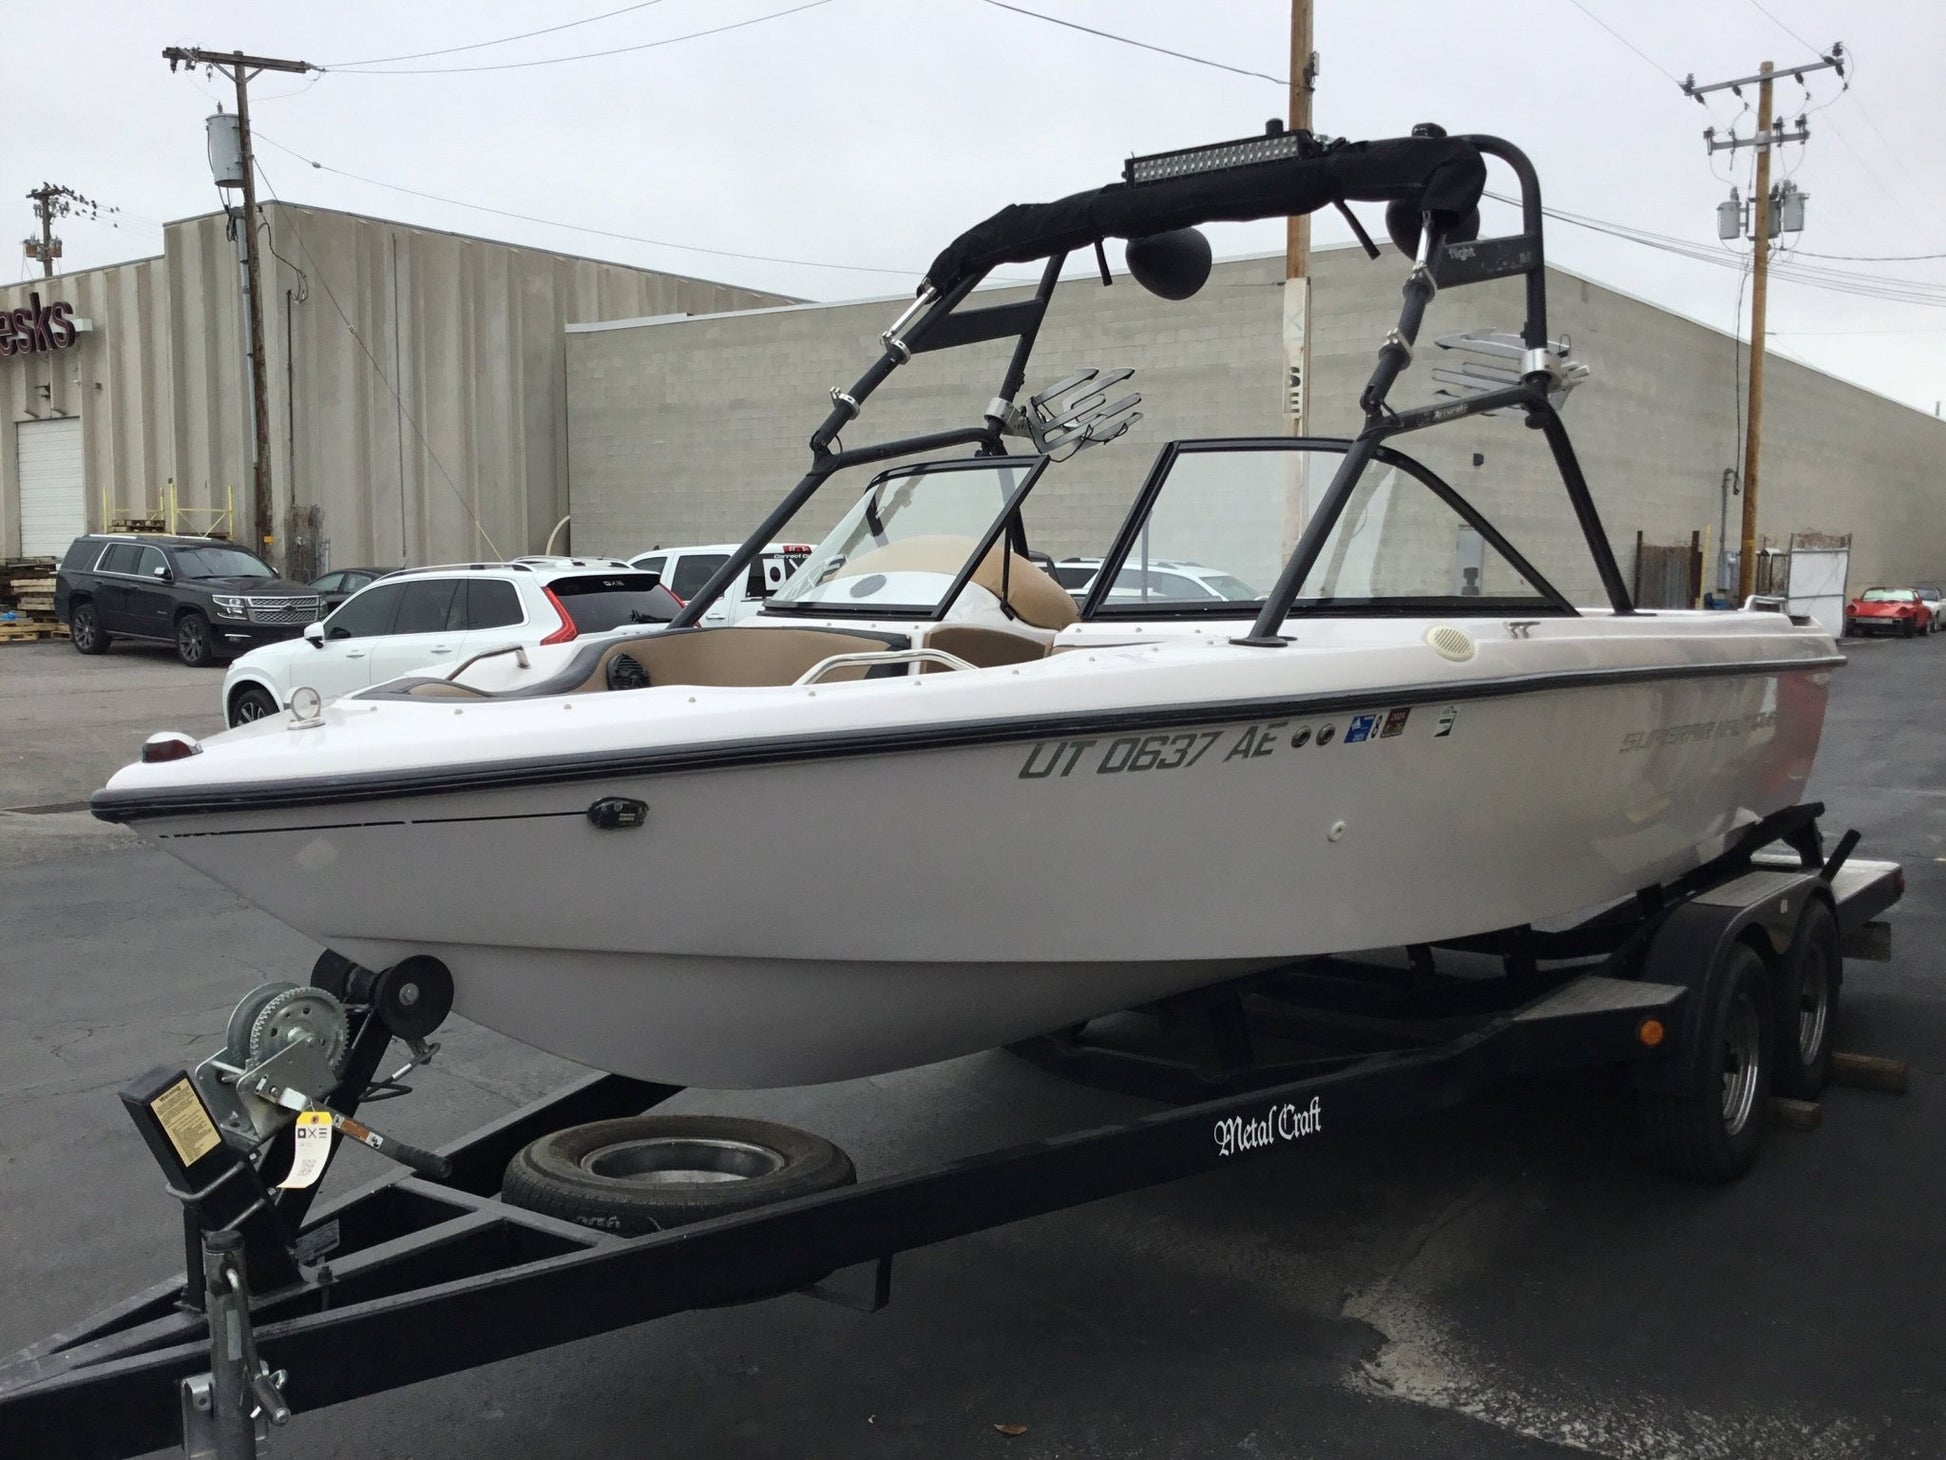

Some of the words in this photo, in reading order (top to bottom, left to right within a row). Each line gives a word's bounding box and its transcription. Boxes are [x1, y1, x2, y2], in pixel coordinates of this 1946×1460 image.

[1018, 739, 1098, 780] UT
[1096, 730, 1225, 775] 0637
[1222, 721, 1289, 763] AE
[1213, 1104, 1278, 1157] Metal
[1277, 1095, 1322, 1141] Craft
